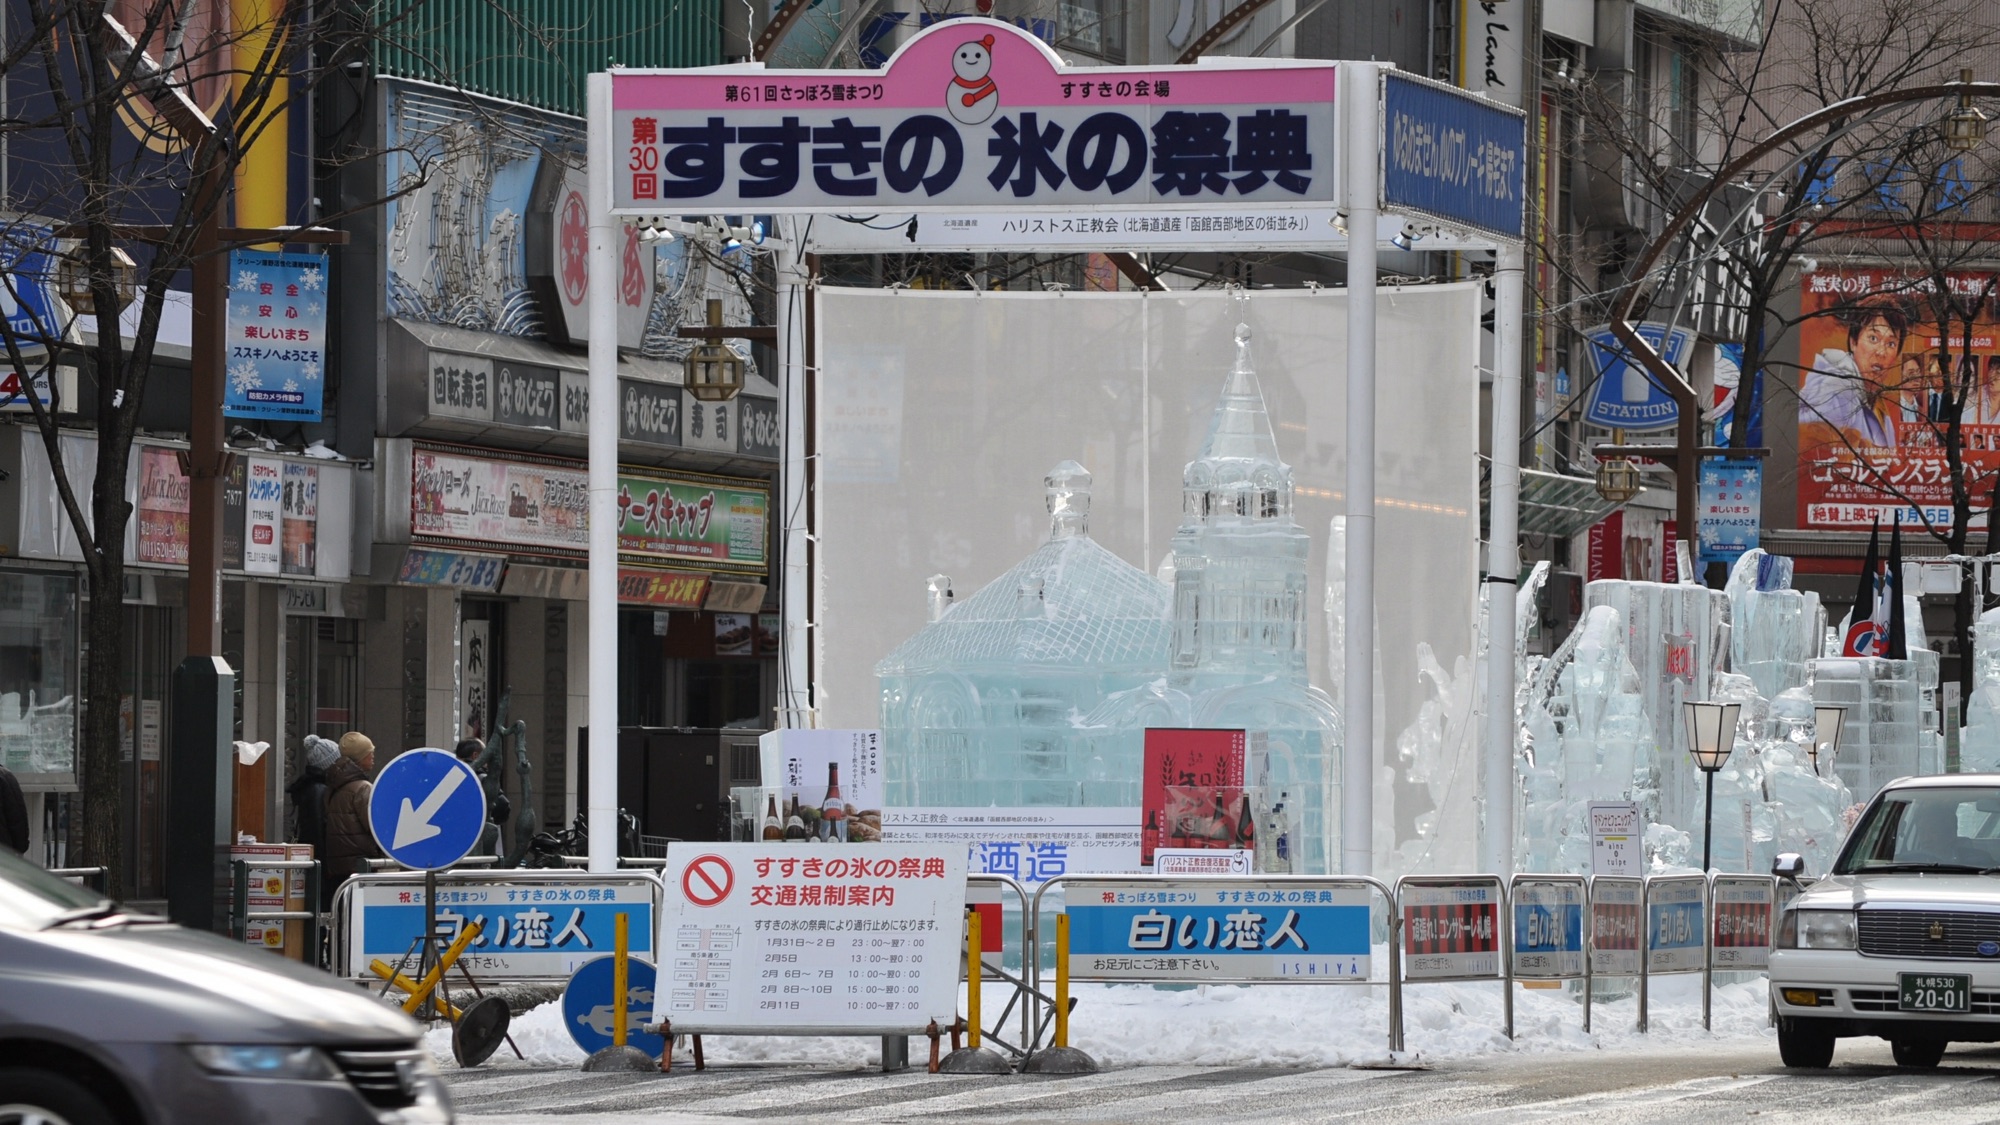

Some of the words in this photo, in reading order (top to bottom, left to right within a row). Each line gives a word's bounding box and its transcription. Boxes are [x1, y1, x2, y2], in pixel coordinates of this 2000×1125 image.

[1485, 22, 1510, 87] Land
[725, 83, 884, 103] 第61回さっぽろ雪まつり
[1060, 80, 1171, 98] すすきの会場
[629, 117, 658, 200] 第30回
[663, 114, 964, 199] すすきの
[987, 108, 1313, 197] 氷の祭典
[244, 326, 310, 341] 楽しいまち
[233, 346, 320, 363] ススキノへようこそ
[433, 365, 488, 411] 回転寿司
[1597, 401, 1674, 418] STATION
[142, 462, 166, 500] JACK
[249, 479, 281, 503] ソングパーク
[618, 483, 715, 540] ナースキャップ
[1709, 505, 1750, 514] 楽しいまち
[1703, 518, 1757, 527] ススキノへようこそ
[1591, 521, 1606, 580] ITALIAN
[753, 857, 945, 879] すすきの氷の祭典
[968, 842, 1068, 883] 酒造
[506, 889, 617, 901] すすきの氷の祭典
[750, 884, 895, 907] 交通規制案内
[1216, 890, 1333, 903] すすきの氷の祭典
[425, 907, 593, 949] 白い恋人
[754, 919, 940, 932] すすきの氷の祭典により通行止めになります。
[1128, 908, 1309, 951] 白い恋人
[764, 953, 798, 963] 2月5日
[1093, 958, 1221, 971] お足元にご注意下さい。
[1282, 962, 1358, 975] ISHIYA
[759, 1000, 800, 1010] 2月11日
[1903, 992, 1913, 1003] あ
[1914, 989, 1965, 1009] 20-01
